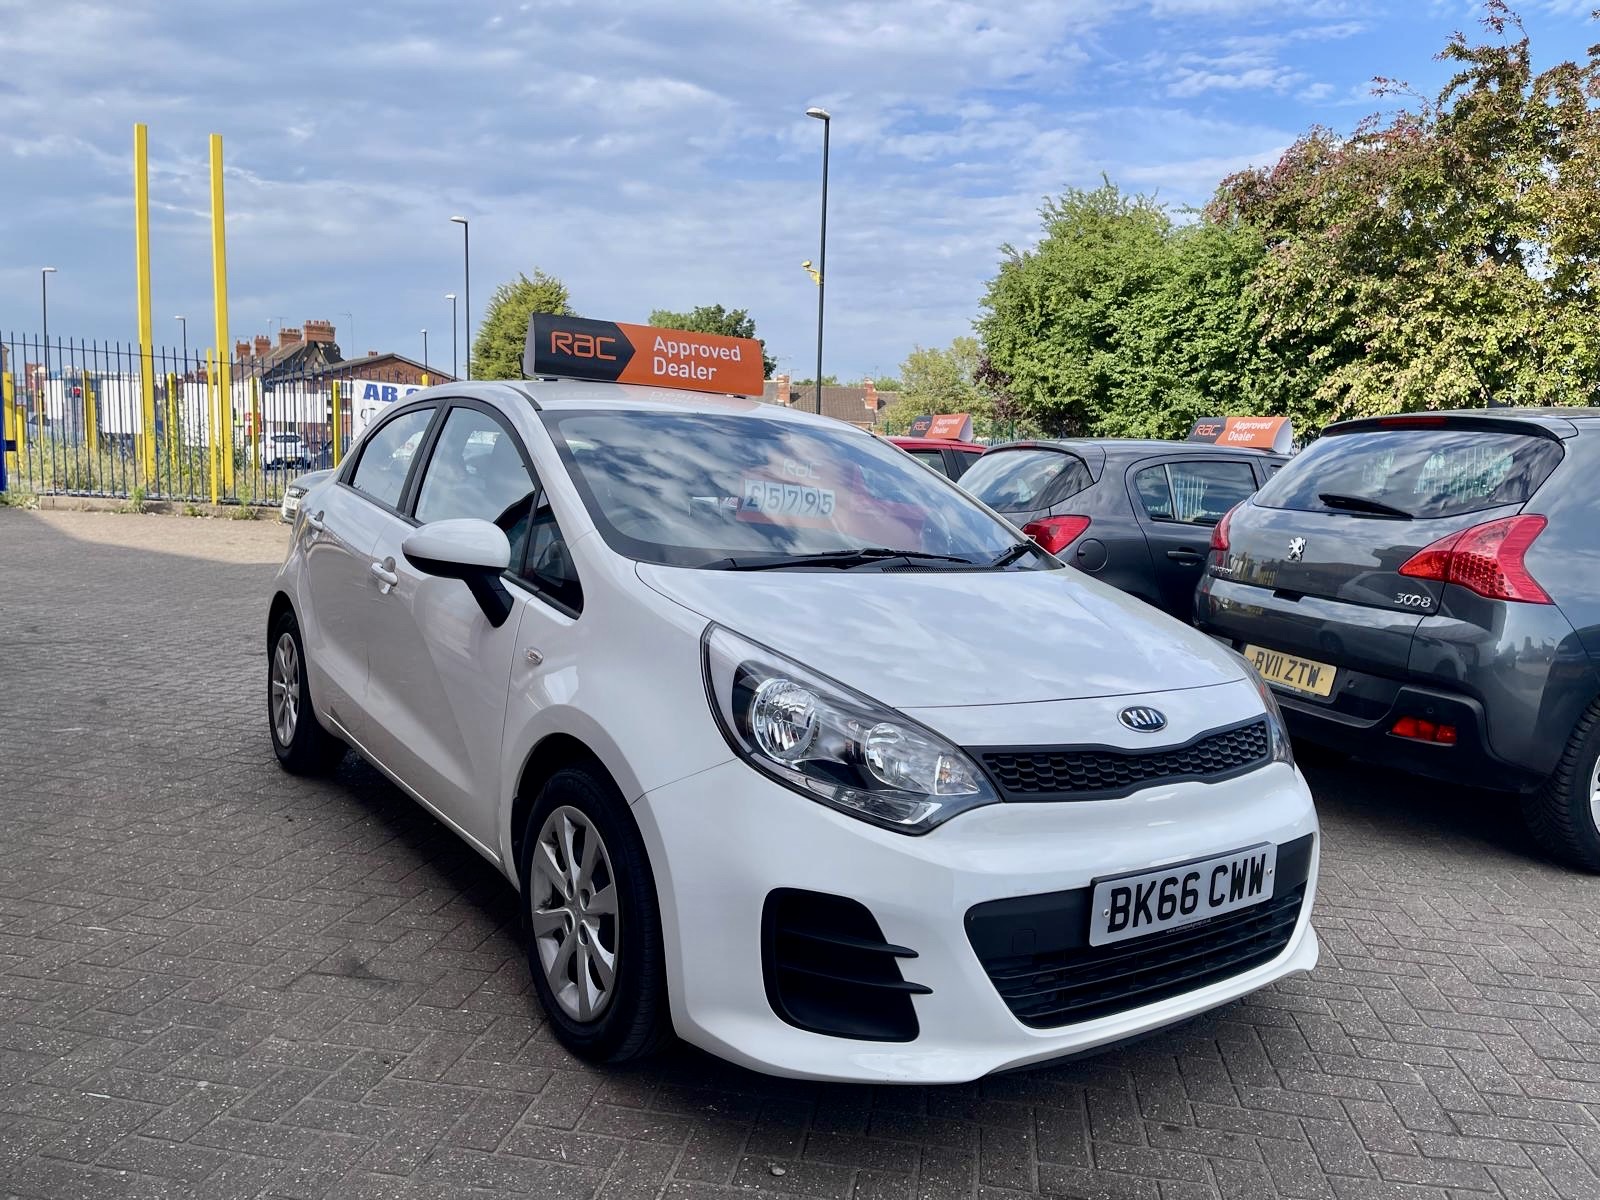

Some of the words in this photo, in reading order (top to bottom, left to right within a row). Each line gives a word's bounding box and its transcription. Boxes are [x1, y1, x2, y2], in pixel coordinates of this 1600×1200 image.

[551, 331, 617, 361] RAC
[653, 336, 741, 362] Approved
[653, 357, 718, 381] Dealer
[363, 383, 398, 403] AB
[932, 426, 949, 434] Dealer
[936, 418, 960, 426] Approved
[1233, 420, 1273, 431] Approved
[1227, 431, 1256, 442] Dealer
[746, 484, 834, 515] £5795
[1393, 592, 1432, 608] 3008
[1284, 659, 1322, 688] ZTW
[1124, 709, 1164, 727] KIA
[1106, 870, 1201, 934] BK66
[1208, 852, 1267, 909] CWW
